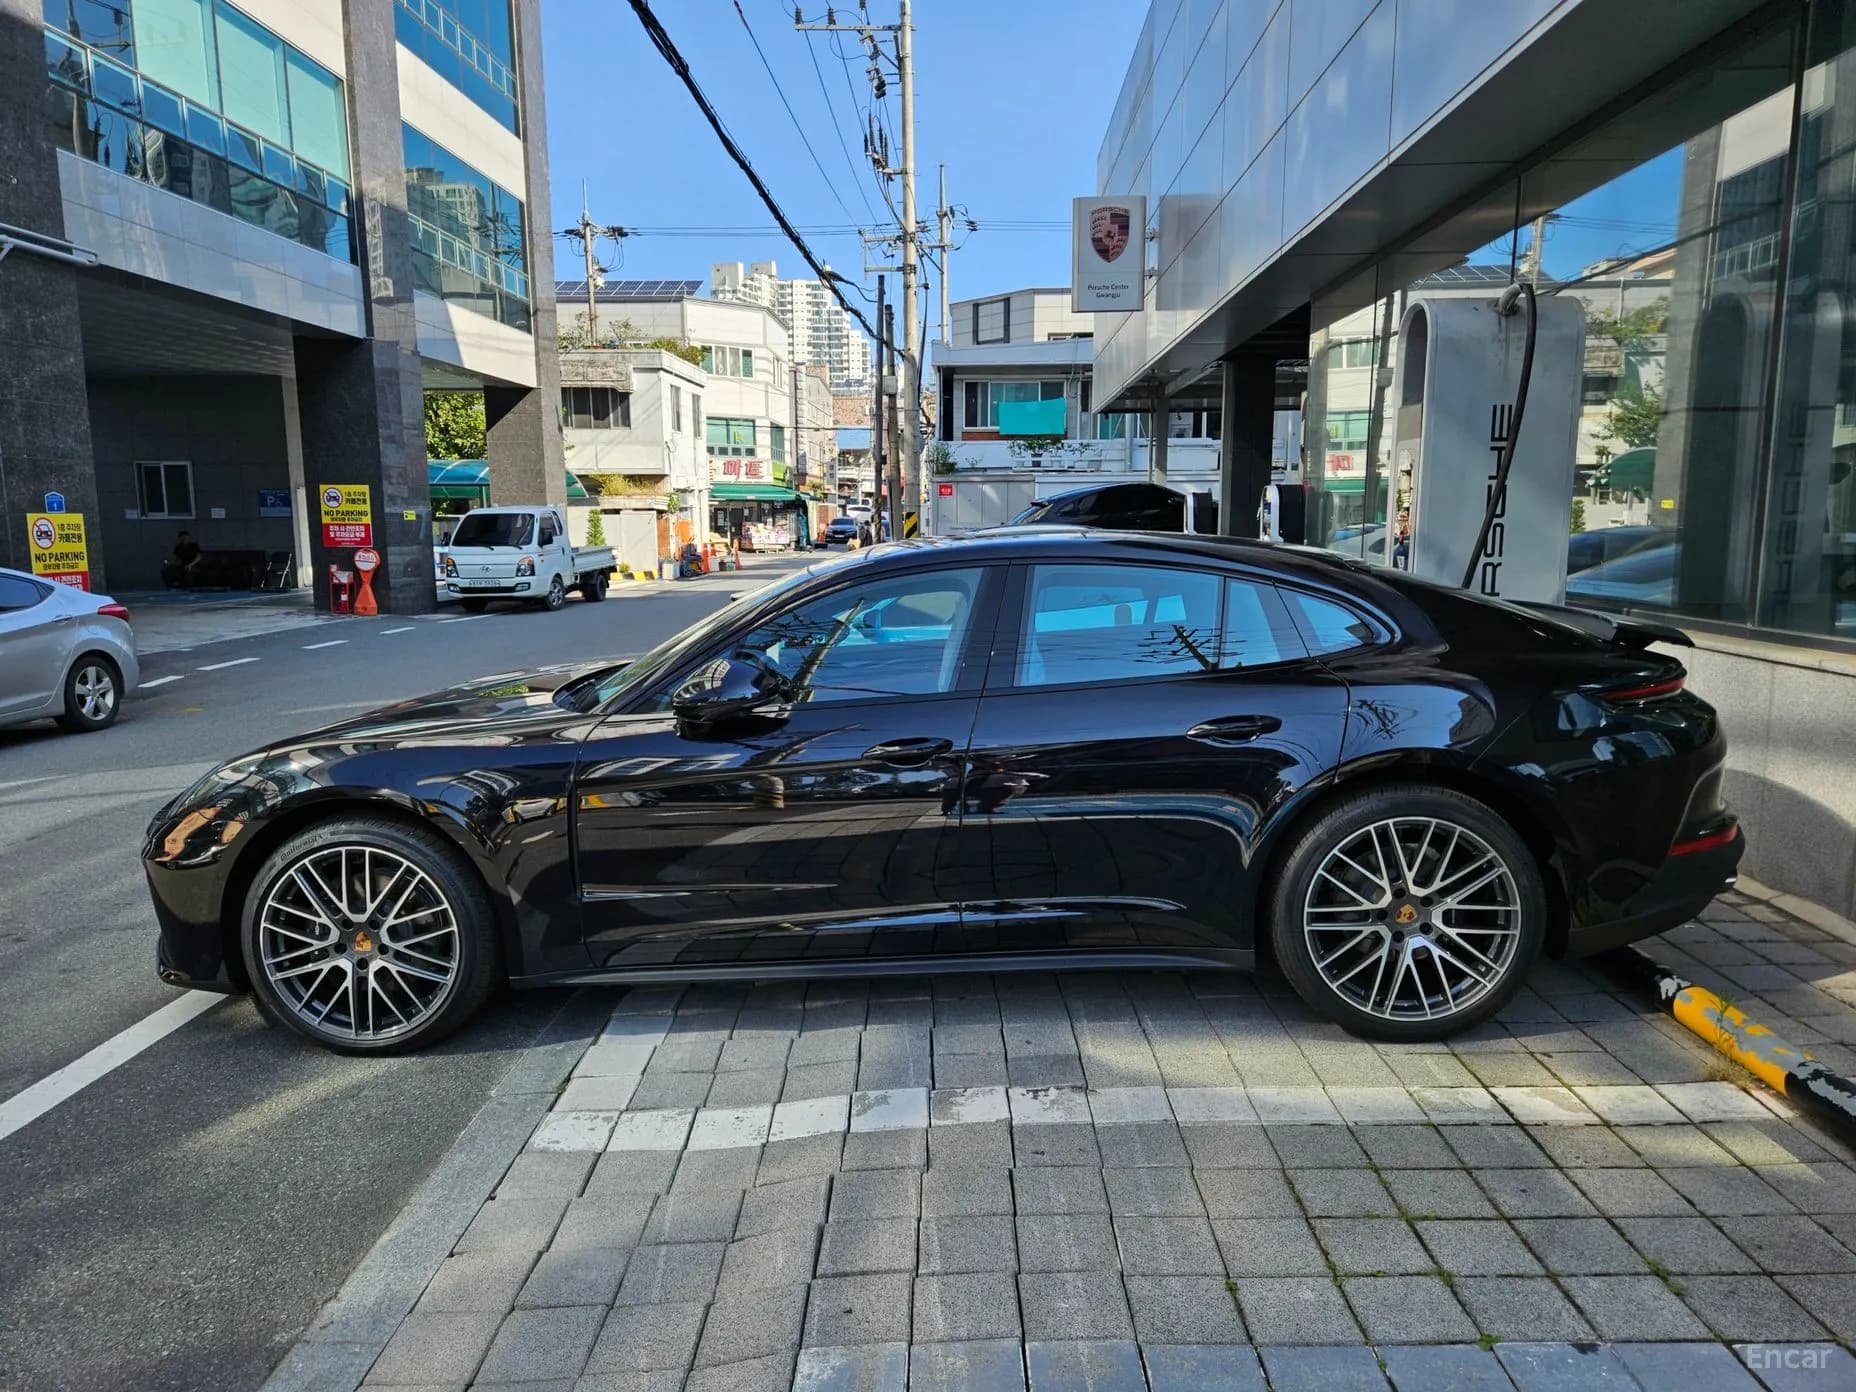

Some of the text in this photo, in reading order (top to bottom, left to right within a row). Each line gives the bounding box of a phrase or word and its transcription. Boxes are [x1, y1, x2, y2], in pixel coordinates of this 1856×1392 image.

[722, 458, 764, 480] 마트
[35, 551, 85, 563] NO PARKING
